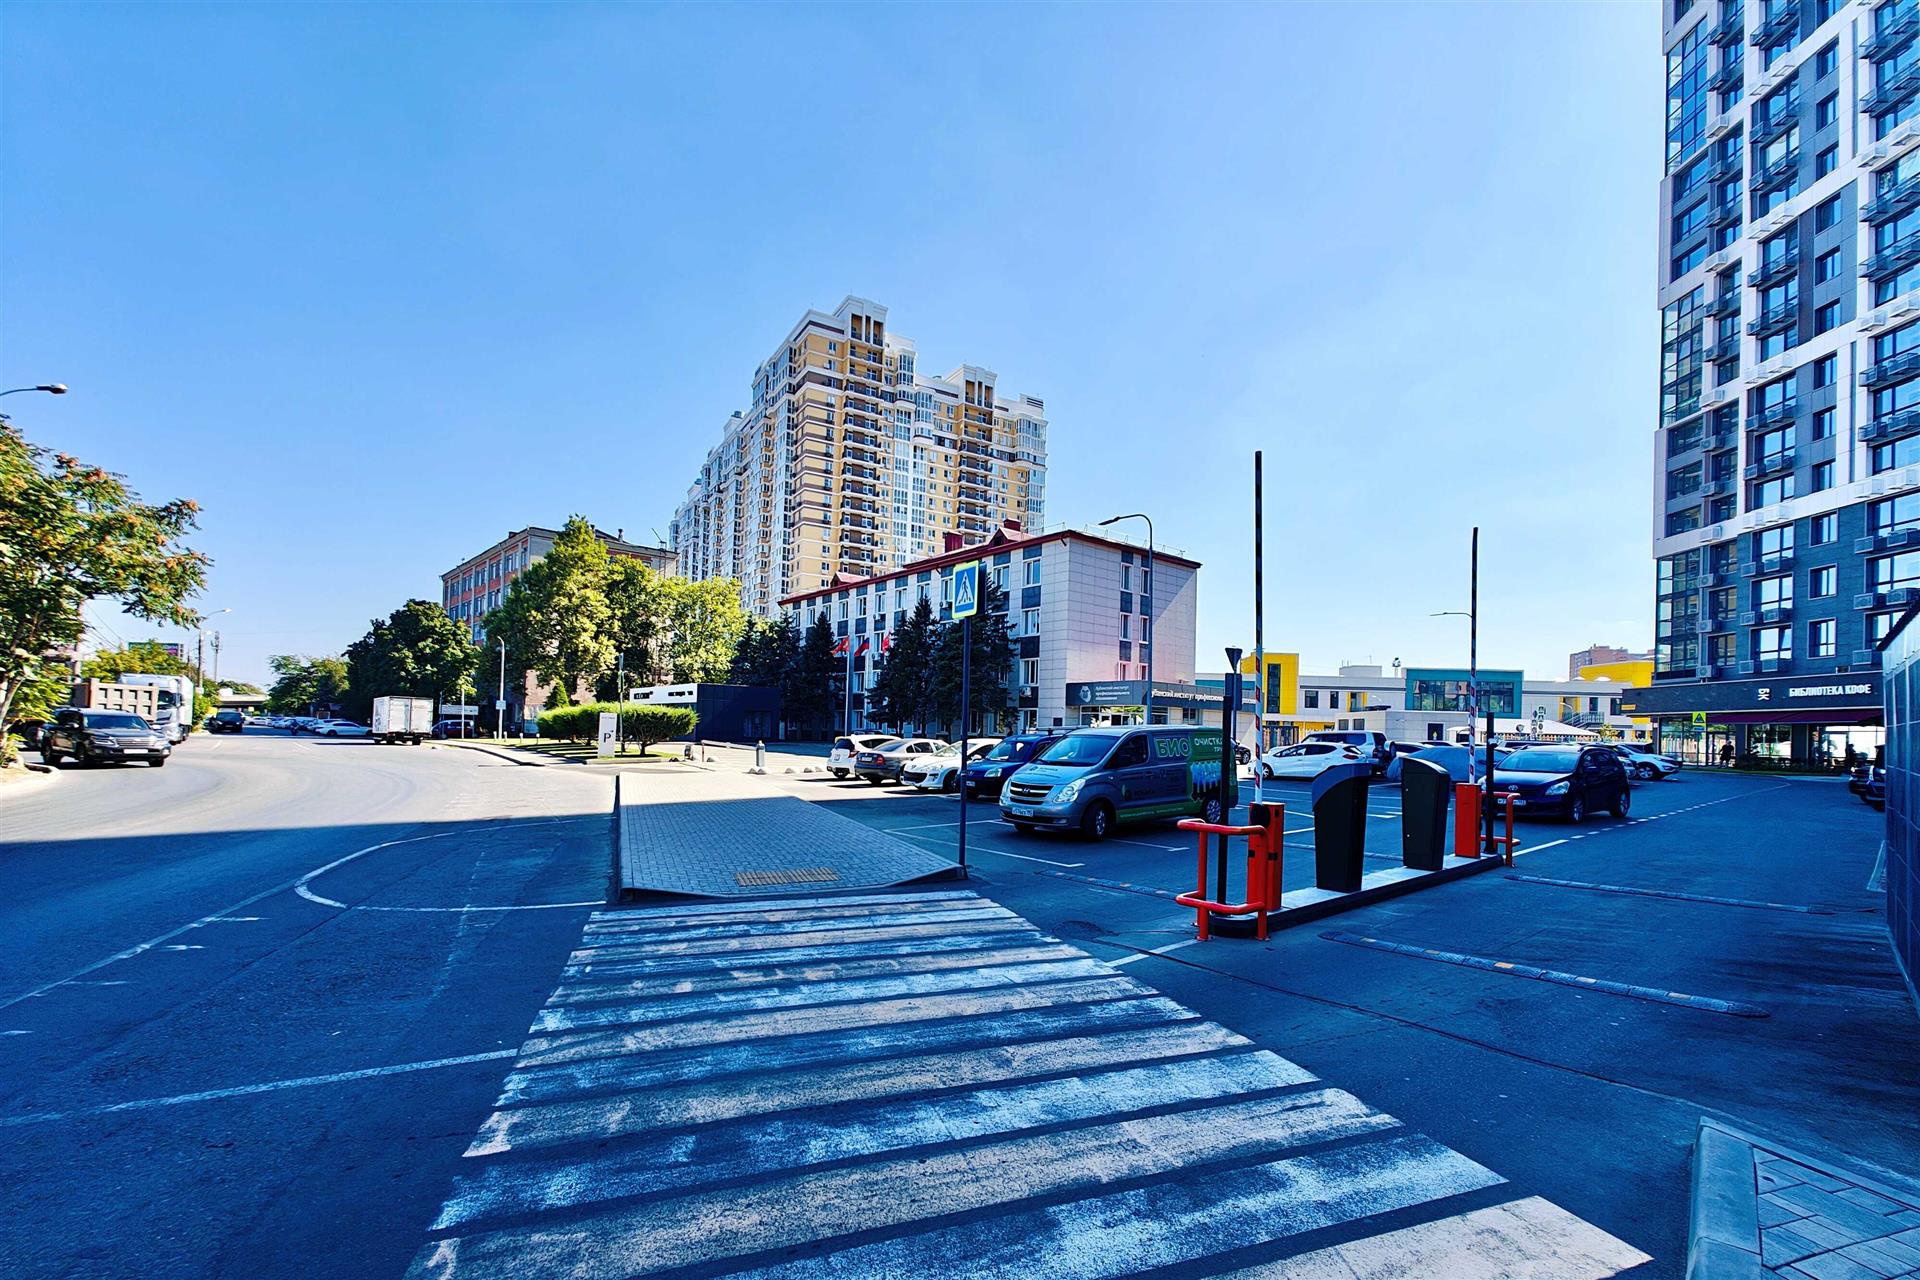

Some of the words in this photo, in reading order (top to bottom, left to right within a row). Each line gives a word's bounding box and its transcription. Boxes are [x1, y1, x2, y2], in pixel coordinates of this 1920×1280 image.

[1151, 688, 1174, 698] убанский
[1789, 686, 1844, 697] БИБЛИОТЕКА
[1845, 684, 1872, 695] КОФЕ
[1155, 737, 1191, 758] БИО
